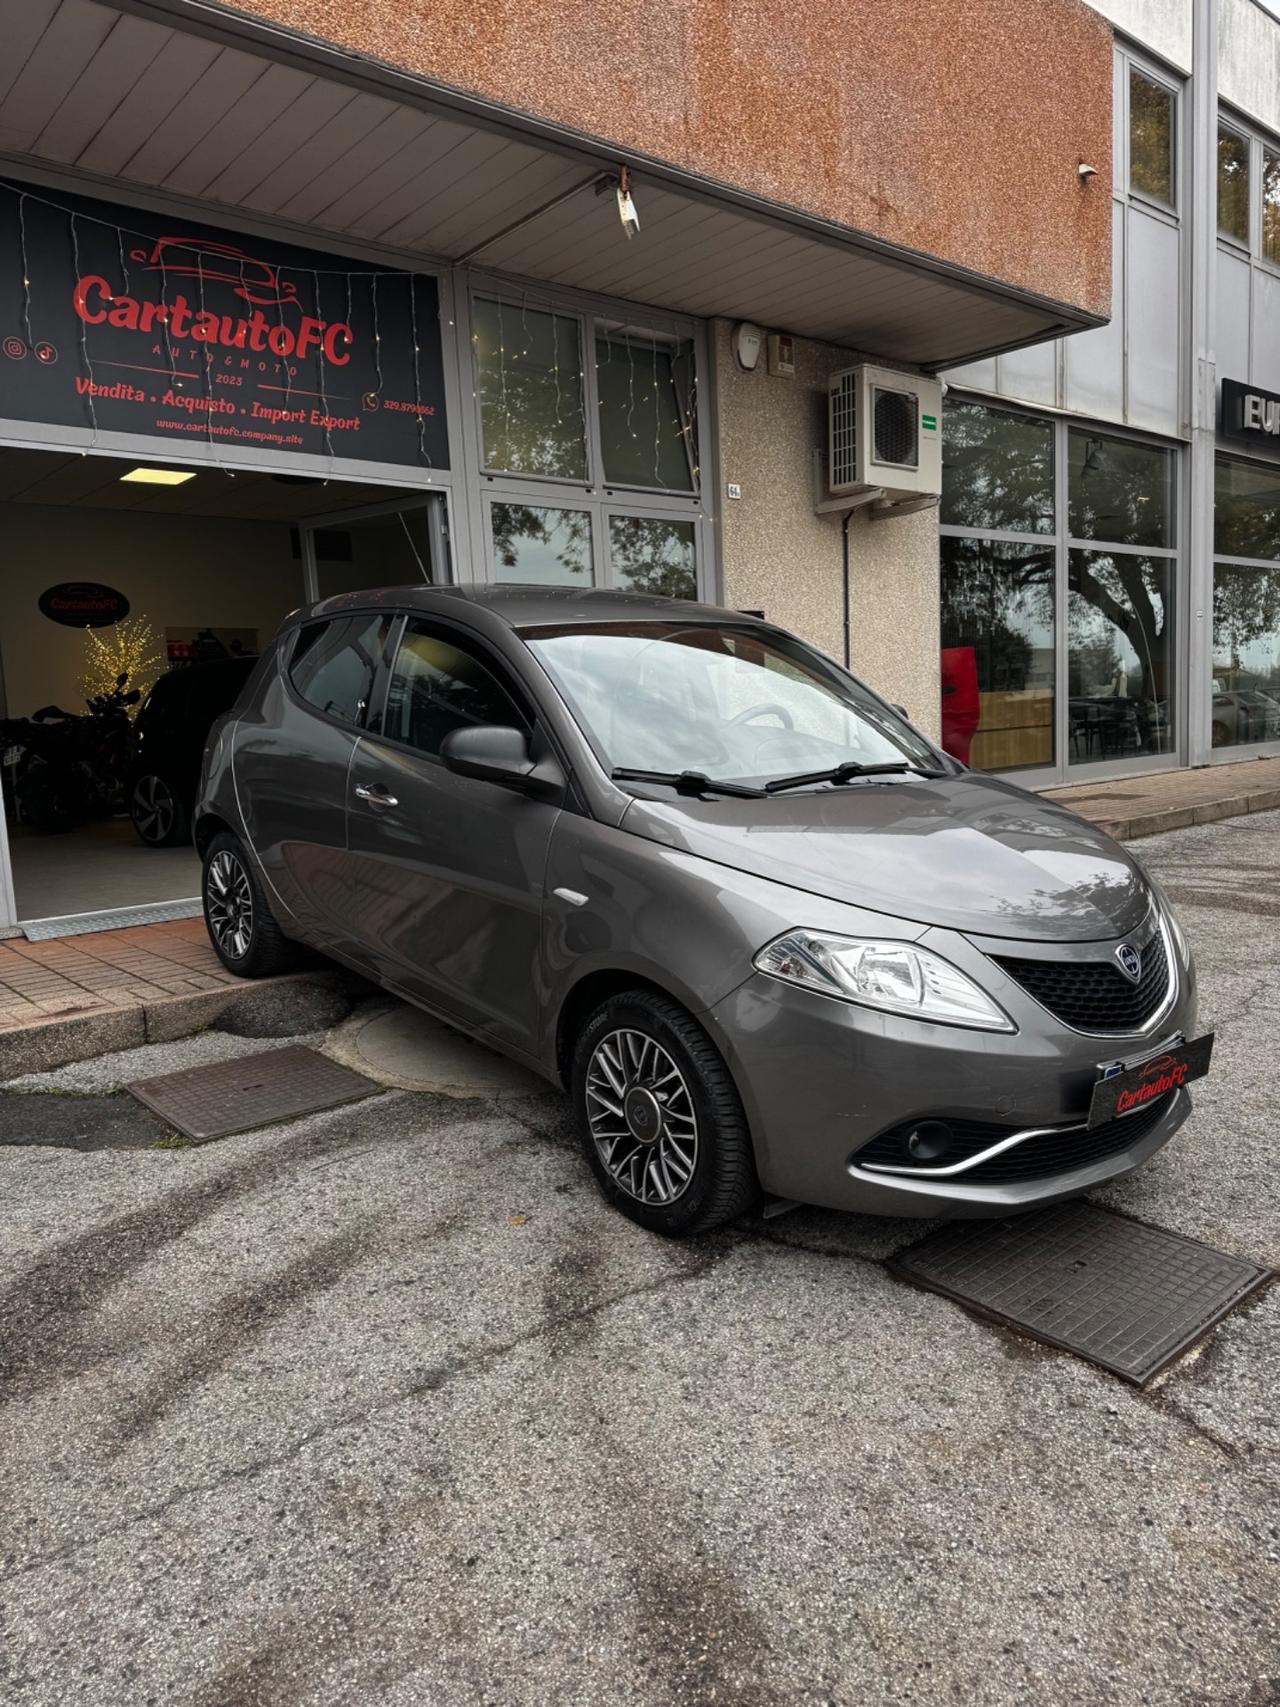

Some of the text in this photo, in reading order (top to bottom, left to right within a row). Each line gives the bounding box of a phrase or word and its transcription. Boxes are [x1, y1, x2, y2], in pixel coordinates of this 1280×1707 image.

[73, 275, 354, 366] CartautoFC
[75, 376, 361, 431] Vendita Acquisto Import Export
[215, 373, 243, 386] 2023
[1116, 1063, 1188, 1113] CartautoFC
